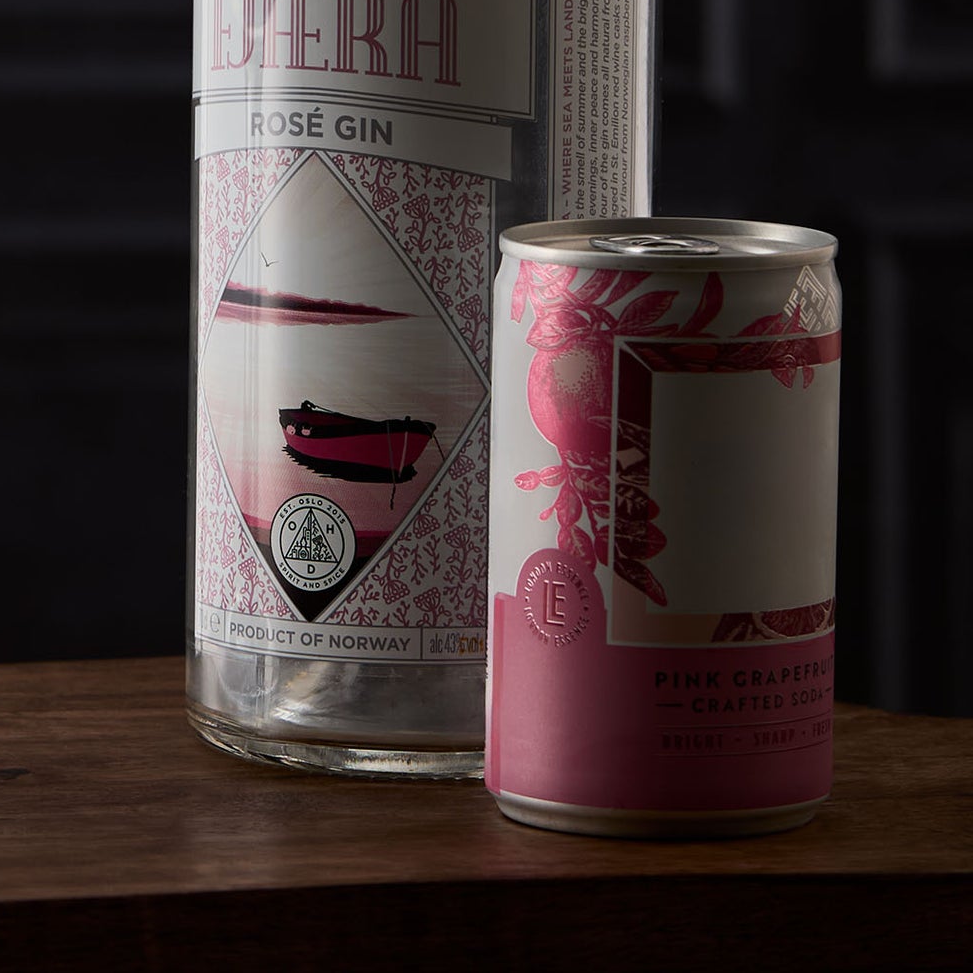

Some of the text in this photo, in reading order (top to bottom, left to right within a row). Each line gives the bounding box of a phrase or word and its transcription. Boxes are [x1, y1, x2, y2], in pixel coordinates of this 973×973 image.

[613, 4, 621, 39] casks
[577, 28, 587, 49] the
[601, 18, 610, 63] natural
[577, 51, 587, 77] and
[589, 50, 598, 75] and
[611, 42, 620, 73] wine
[563, 46, 573, 97] MEETS
[601, 66, 609, 81] all
[590, 78, 599, 118] peace
[611, 75, 619, 98] red
[621, 50, 629, 121] Norwegian
[563, 102, 572, 133] SEA
[577, 79, 586, 133] summer
[251, 107, 393, 146] ROSÉ GIN
[588, 119, 597, 153] inner
[600, 129, 610, 150] gin
[620, 124, 628, 154] from
[575, 134, 585, 149] of
[561, 137, 572, 195] WHERE
[575, 152, 585, 186] smell
[600, 153, 608, 174] the
[610, 153, 619, 169] St.
[588, 157, 598, 216] evenings,
[600, 176, 608, 191] of
[610, 173, 618, 184] in
[620, 157, 628, 202] flavour
[575, 189, 585, 210] the
[280, 504, 296, 519] EST.
[326, 505, 346, 524] 2015
[288, 521, 297, 531] O
[326, 524, 335, 535] H
[279, 562, 345, 589] SPIRIT AND SPICE
[307, 564, 316, 574] D
[229, 622, 411, 652] PRODUCT OF NORWAY
[654, 670, 720, 689] PINK
[691, 688, 823, 713] CRAFTED SODA
